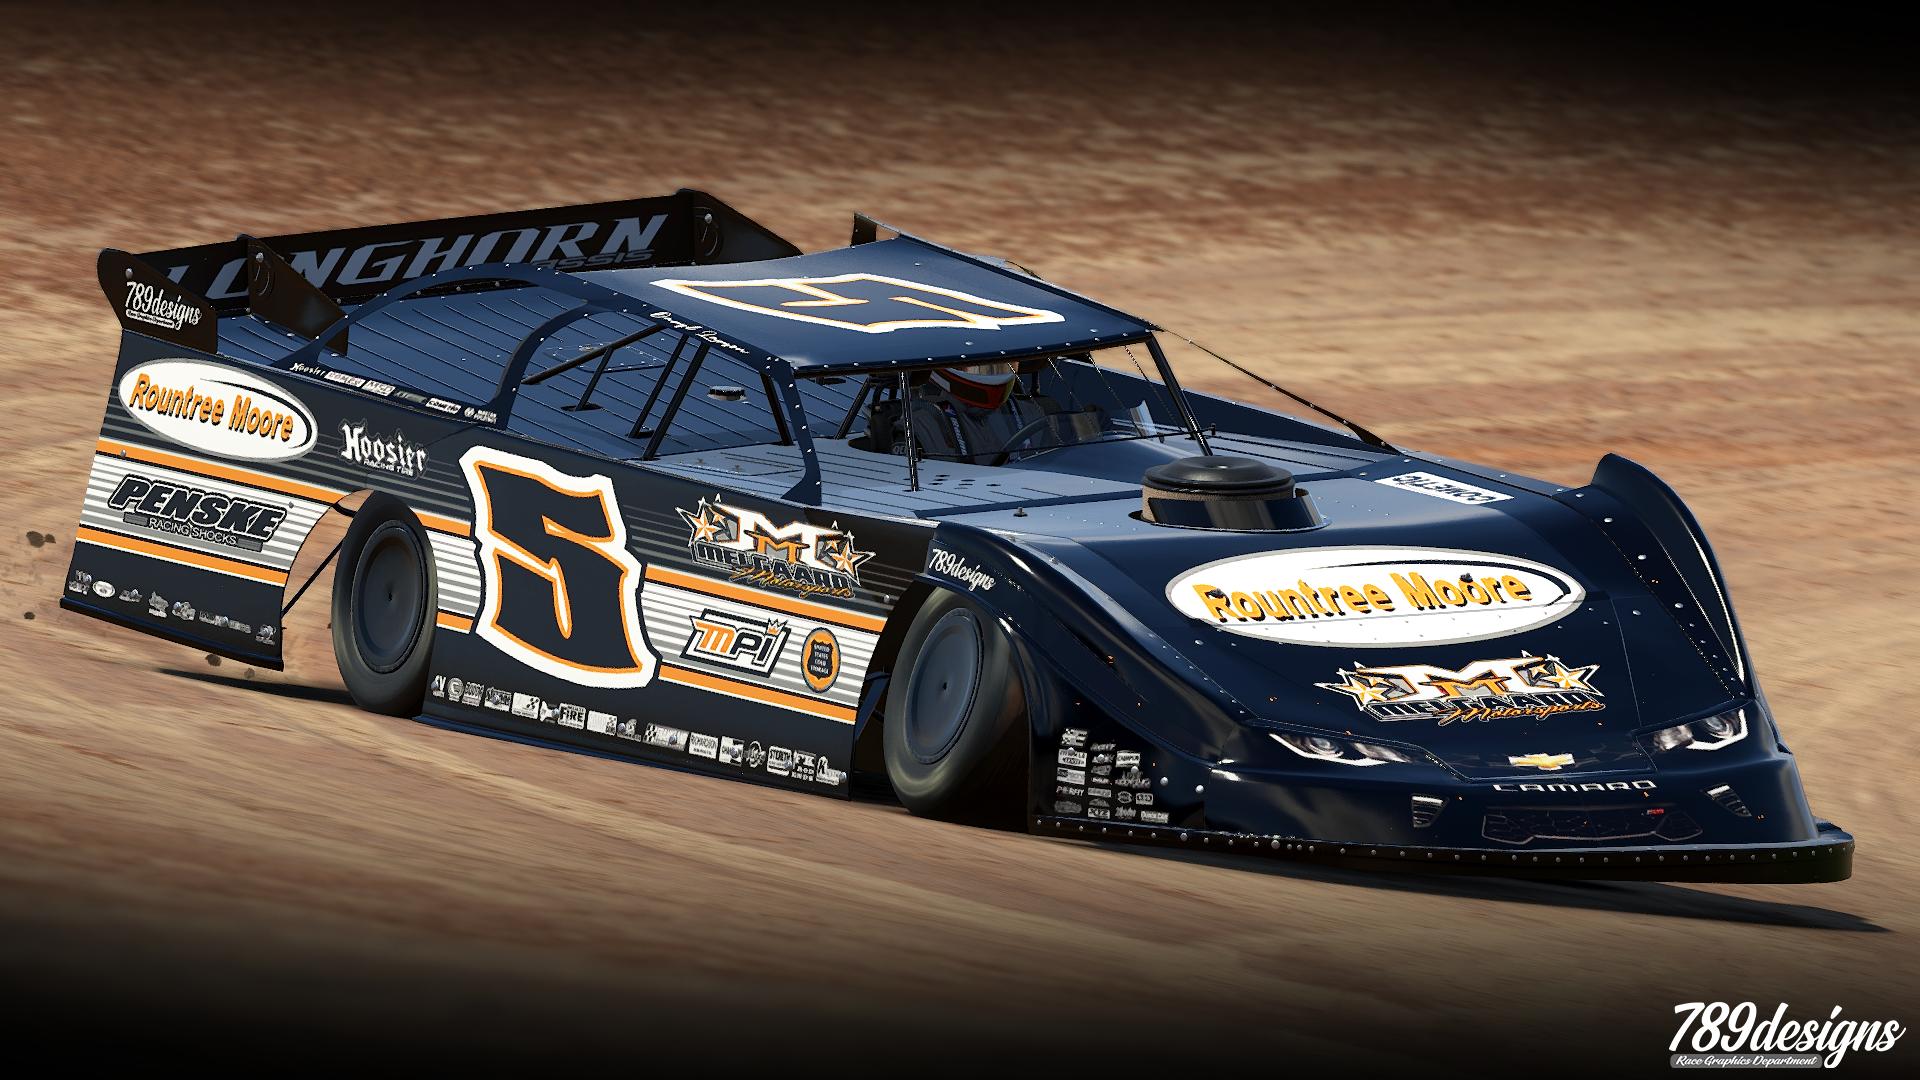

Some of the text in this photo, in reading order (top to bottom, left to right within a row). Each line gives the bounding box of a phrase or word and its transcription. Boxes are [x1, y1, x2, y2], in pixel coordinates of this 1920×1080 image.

[532, 249, 655, 270] ASSIS
[125, 281, 203, 331] 789designs
[129, 373, 294, 442] Rountree Moore
[341, 423, 426, 472] Hoosier
[108, 474, 287, 542] PENSKE
[149, 517, 237, 545] RACING SHOCKS
[459, 445, 656, 688] 5
[928, 548, 997, 592] 789designs
[1192, 571, 1534, 623] Rountree Moore
[1492, 779, 1657, 793] CAMARO
